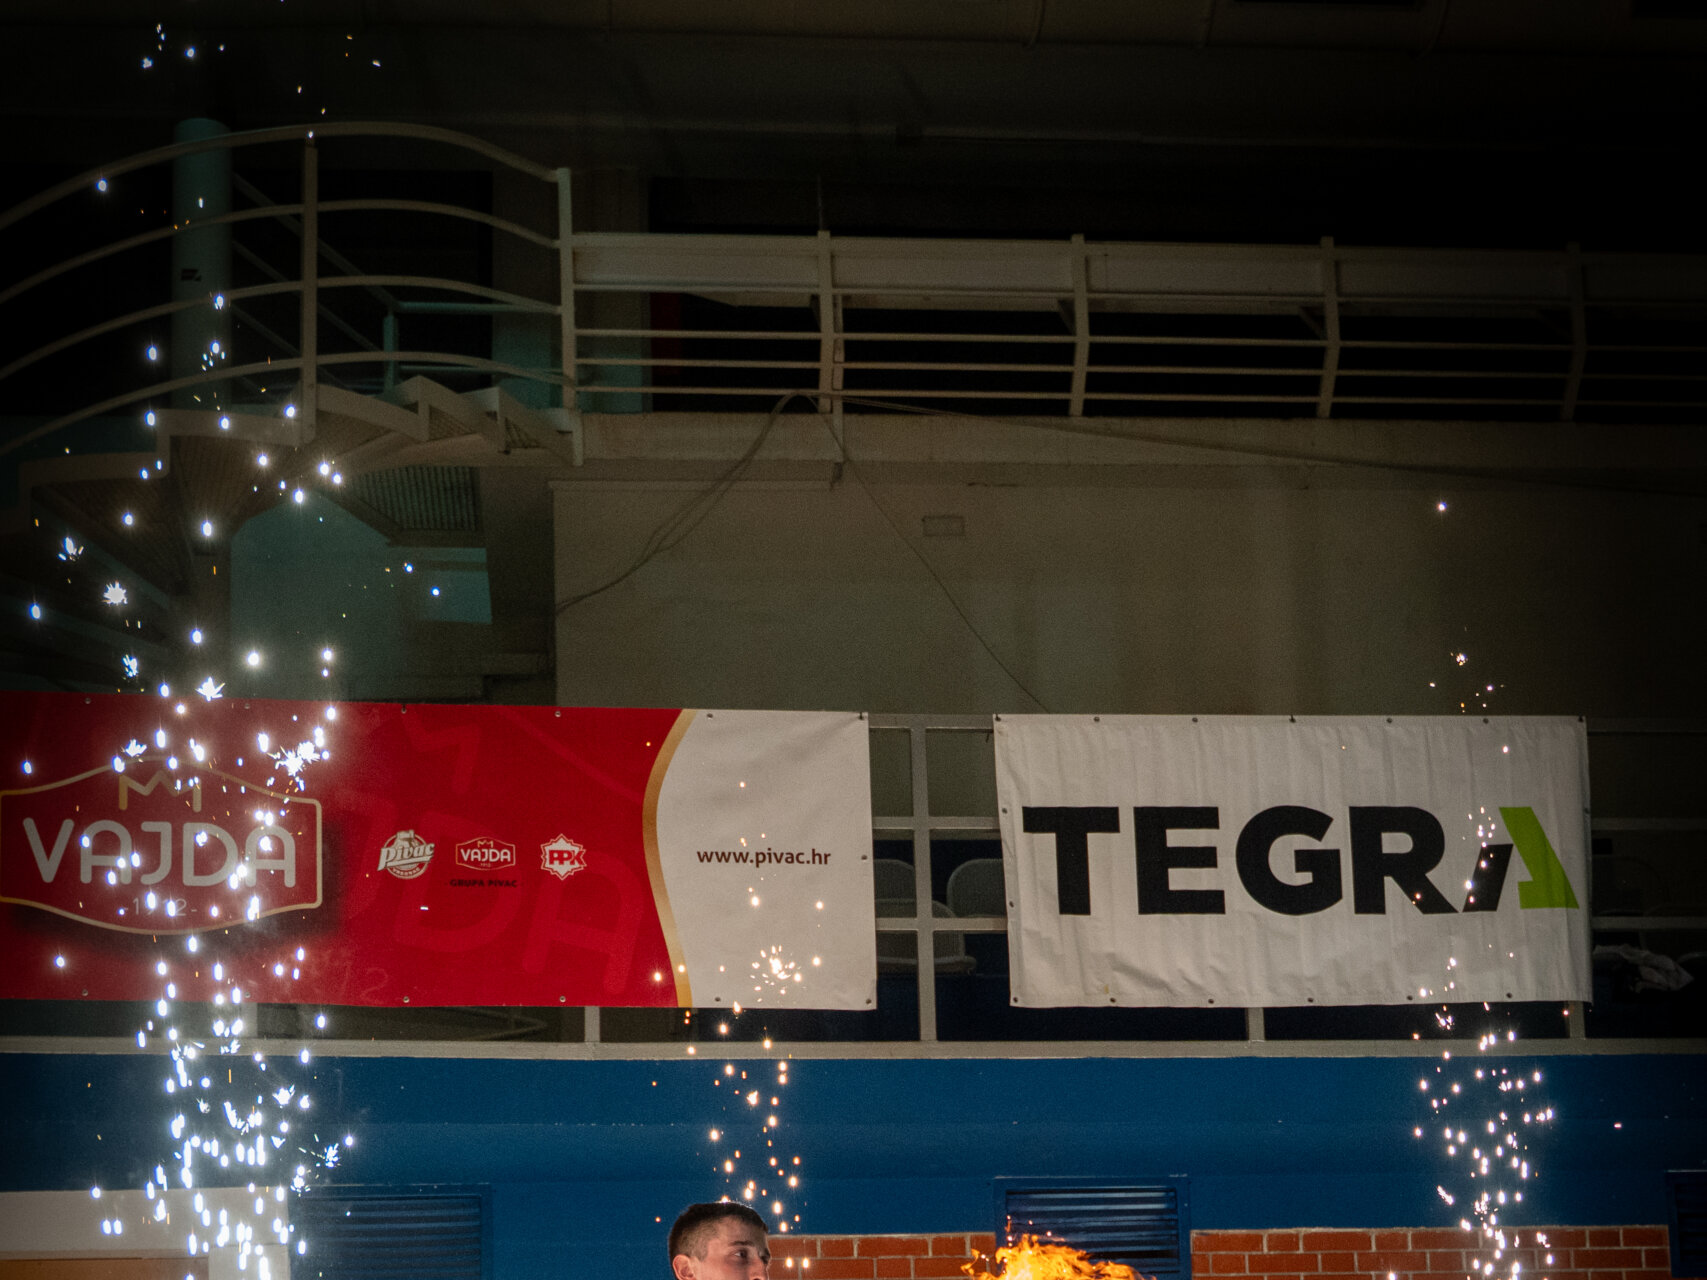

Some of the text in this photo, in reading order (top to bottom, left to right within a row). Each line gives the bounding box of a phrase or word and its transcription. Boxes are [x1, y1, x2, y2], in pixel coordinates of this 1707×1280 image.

[22, 818, 296, 887] VAJDA
[460, 848, 512, 862] VAJDA
[549, 850, 585, 865] PPK
[697, 848, 832, 867] www.pivac.hr
[1022, 805, 1580, 916] TEGRA
